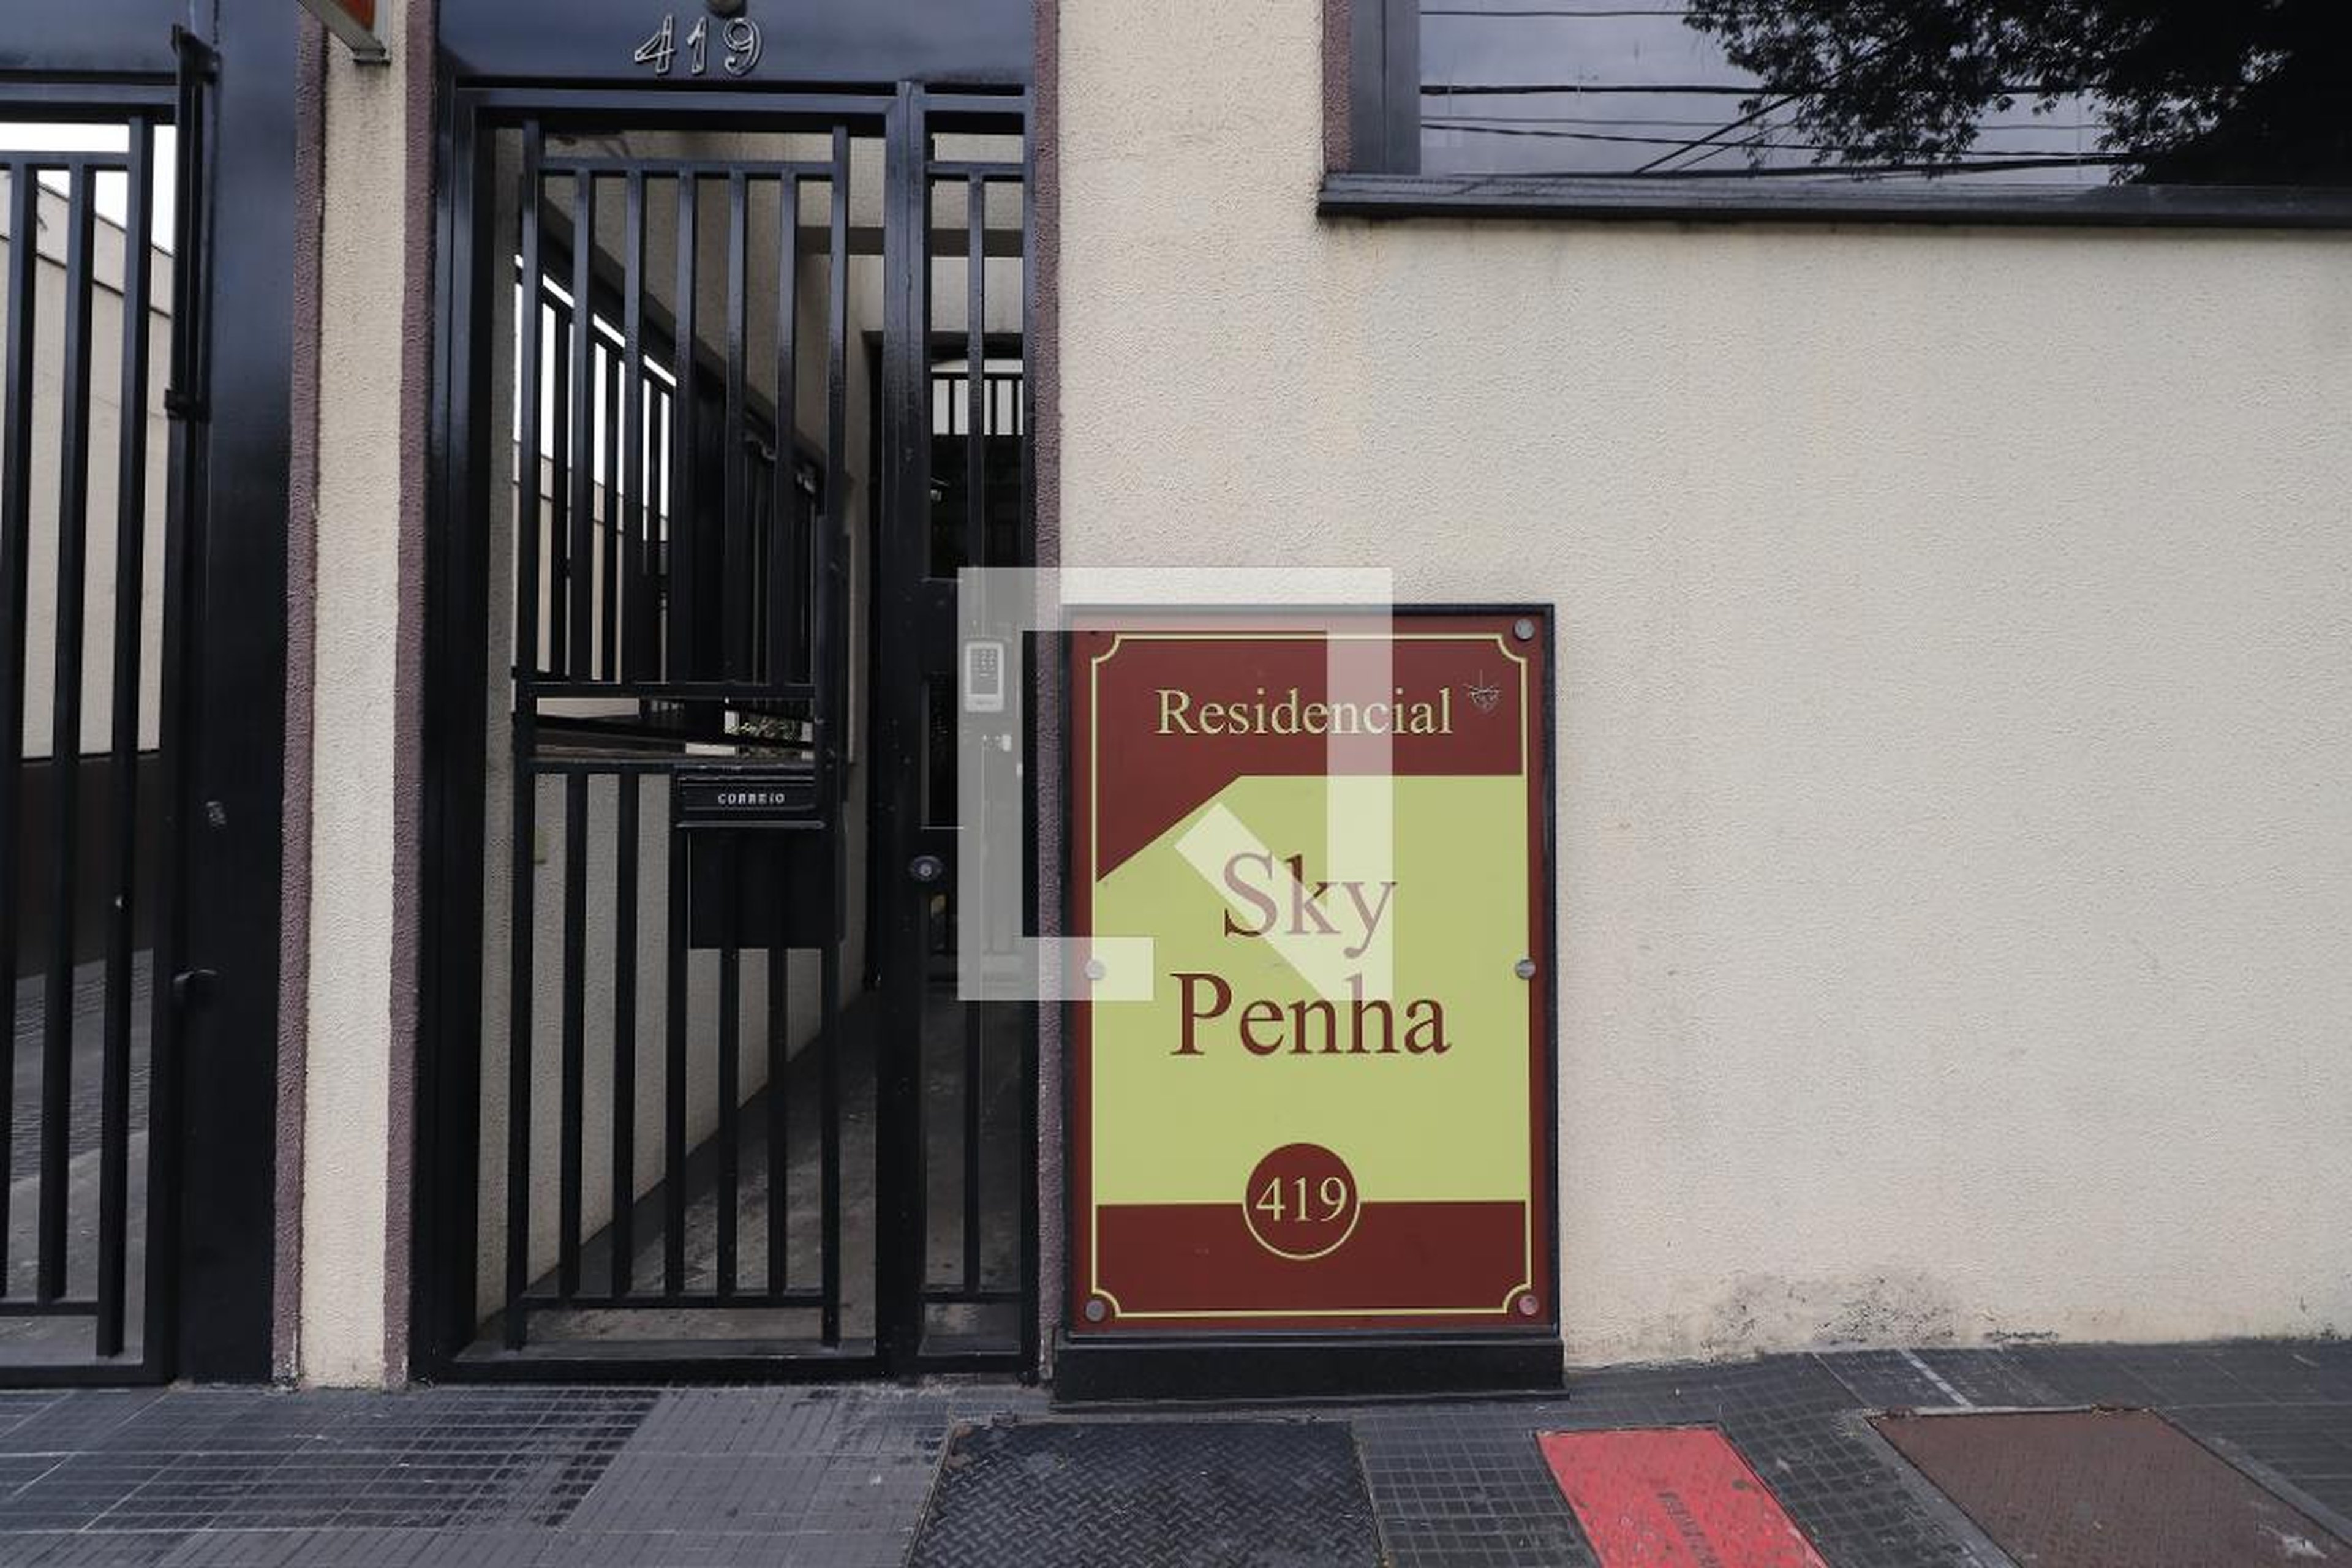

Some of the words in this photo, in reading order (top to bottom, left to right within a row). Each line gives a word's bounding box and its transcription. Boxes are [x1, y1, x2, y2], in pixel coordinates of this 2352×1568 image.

[635, 13, 762, 75] 419
[1156, 688, 1453, 736] Residencial
[1223, 851, 1398, 958] Sky
[1170, 971, 1452, 1057] Penha
[1256, 1176, 1348, 1223] 419
